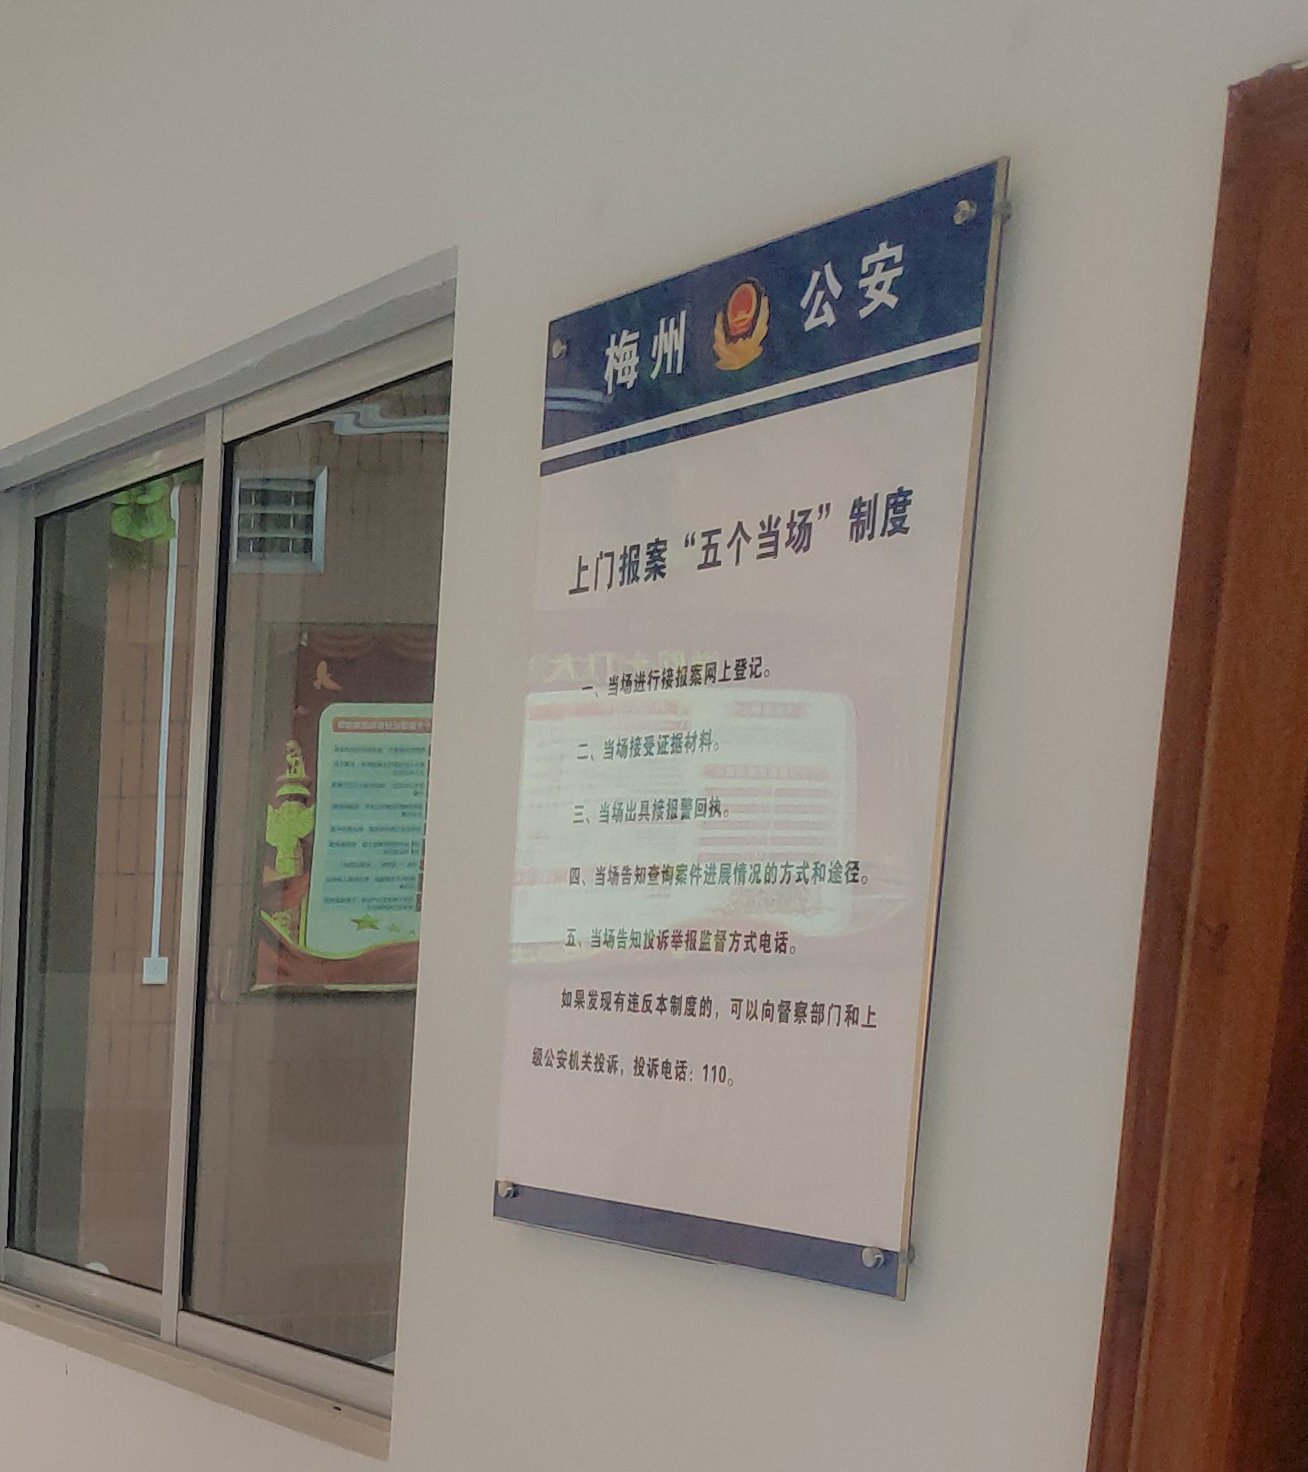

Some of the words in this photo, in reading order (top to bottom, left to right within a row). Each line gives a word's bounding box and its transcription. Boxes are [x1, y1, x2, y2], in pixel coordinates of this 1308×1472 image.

[603, 310, 688, 394] 梅州
[799, 241, 904, 333] 公安
[568, 486, 913, 596] 上门报案“五个当场”制度
